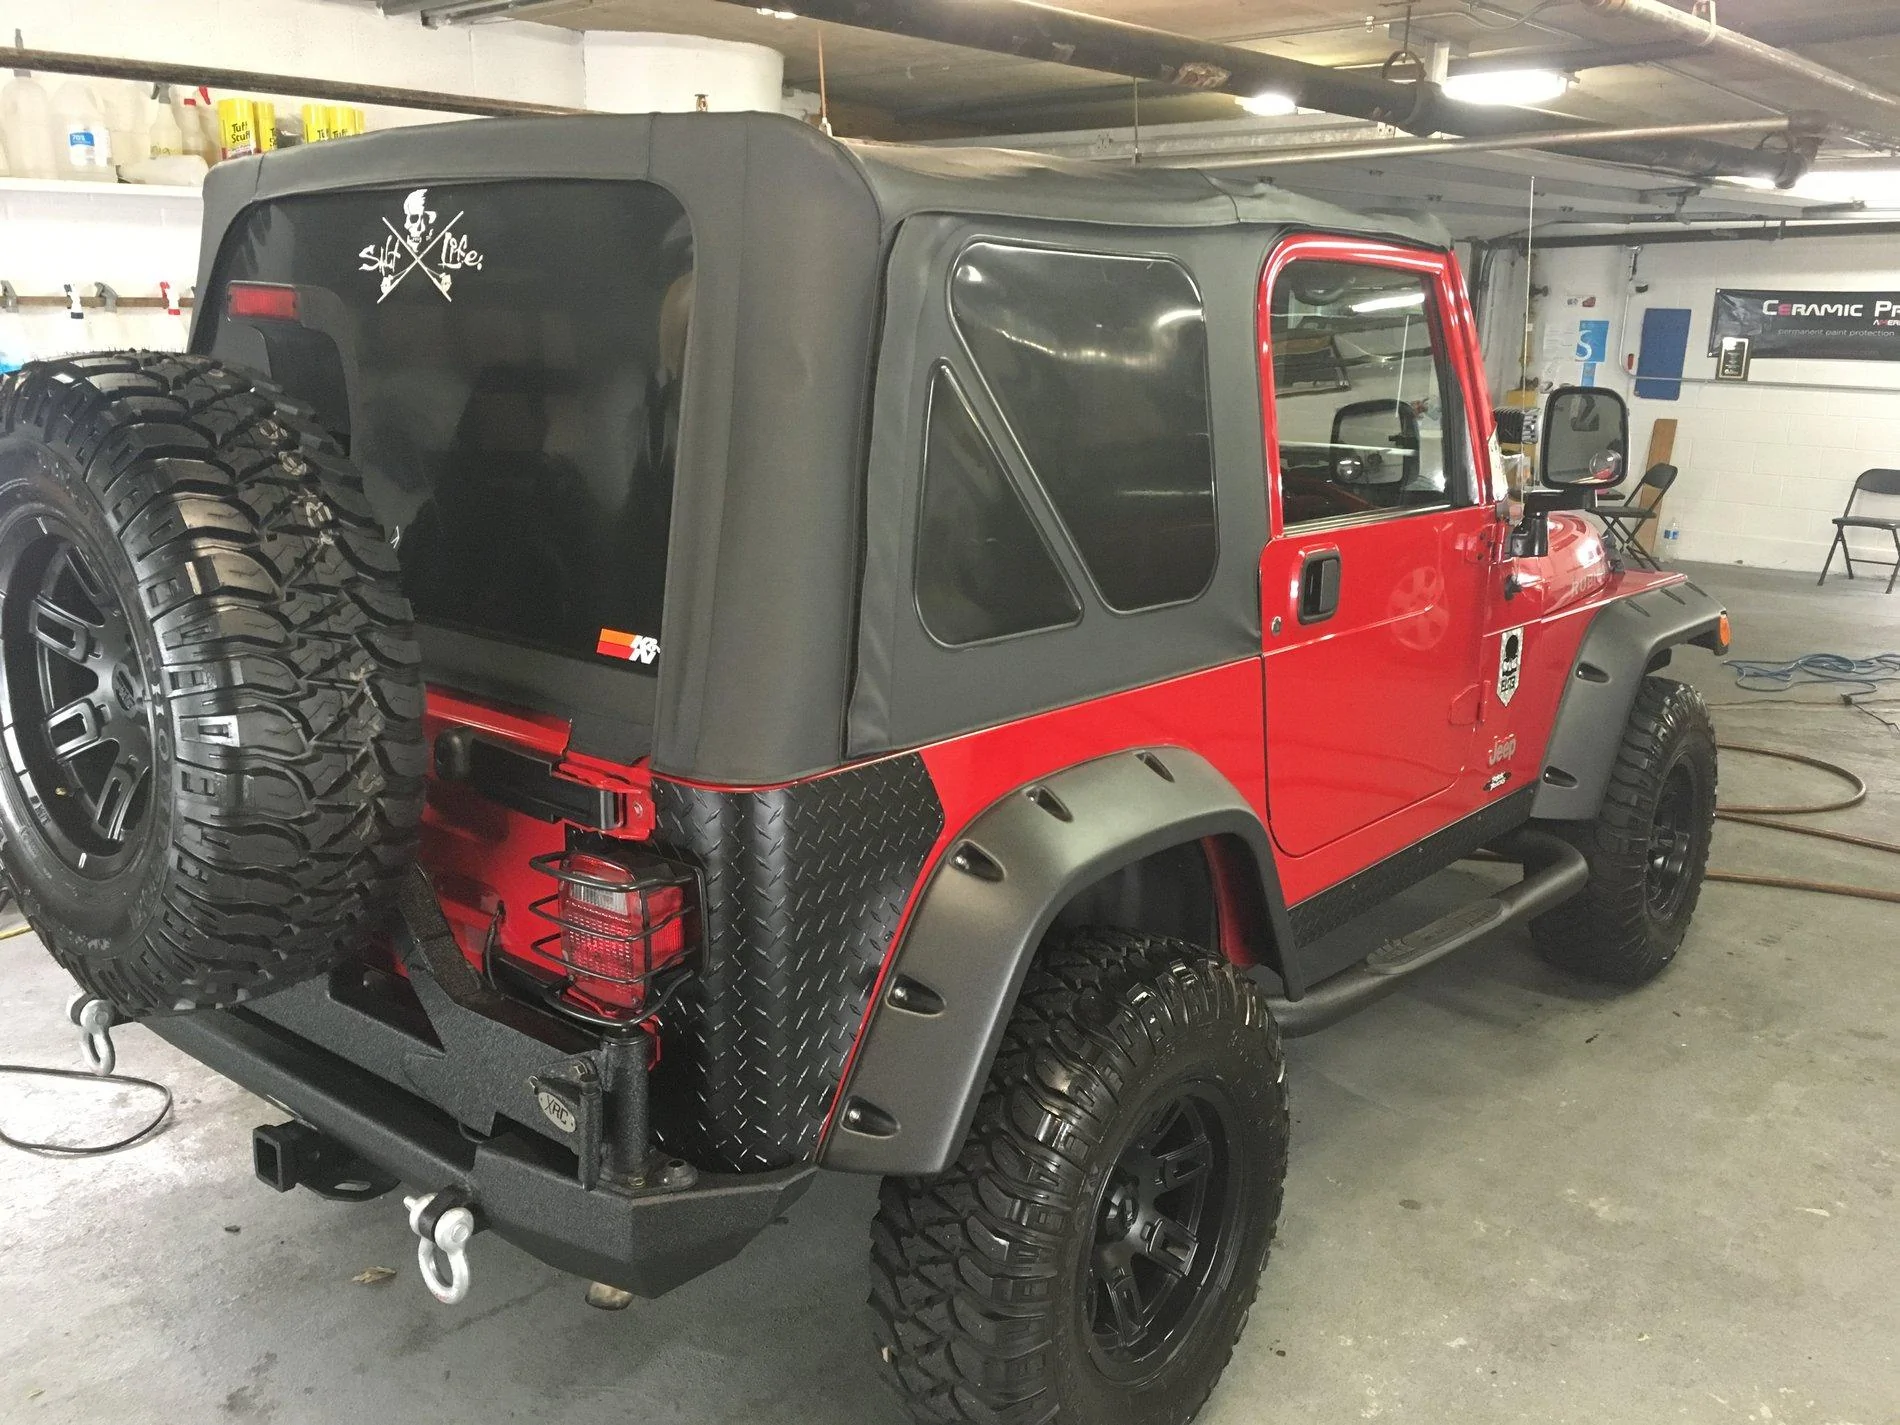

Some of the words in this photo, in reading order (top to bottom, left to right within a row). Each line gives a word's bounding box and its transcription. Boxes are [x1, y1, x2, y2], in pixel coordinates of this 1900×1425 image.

[1762, 299, 1864, 317] CERAMIC
[1777, 328, 1824, 336] permanent
[1825, 329, 1847, 337] paint
[1848, 329, 1895, 337] protection
[1488, 734, 1516, 766] Jeep
[544, 1094, 569, 1125] XRC
